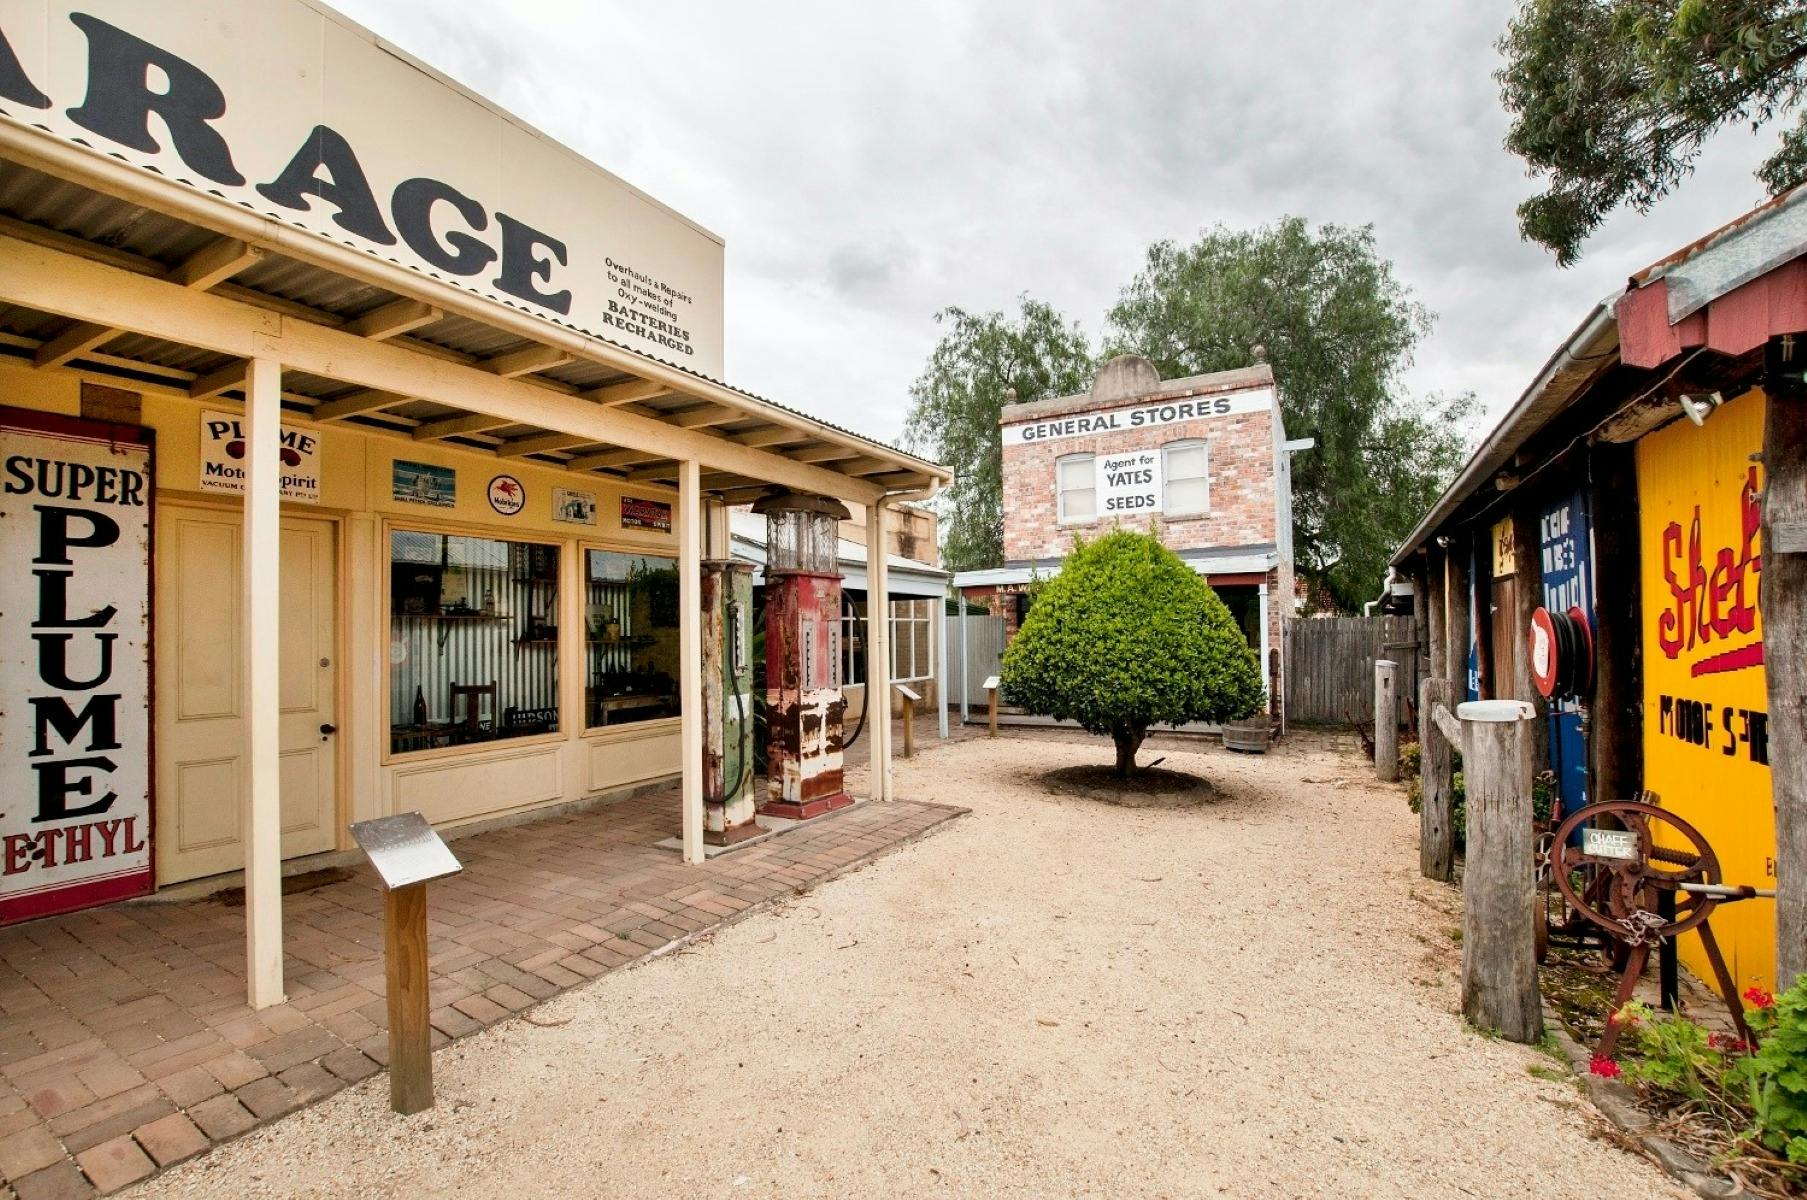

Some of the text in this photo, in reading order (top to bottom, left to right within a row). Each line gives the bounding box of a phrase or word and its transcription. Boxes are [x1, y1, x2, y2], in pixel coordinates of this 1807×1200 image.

[605, 257, 692, 304] Overhauls & Repairs
[607, 271, 673, 308] to all makes of
[602, 312, 694, 355] RECHARGED
[607, 299, 690, 341] BATTERIES
[207, 421, 316, 456] PLME
[1022, 398, 1232, 441] GENERAL STORES
[4, 455, 144, 507] SUPER
[278, 474, 316, 488] pirit
[1104, 455, 1154, 471] Agent for
[1106, 469, 1153, 487] YATES
[202, 480, 237, 489] VACUUM
[1106, 494, 1156, 510] SEEDS
[28, 504, 121, 824] PLUME
[2, 818, 145, 877] ETHYL
